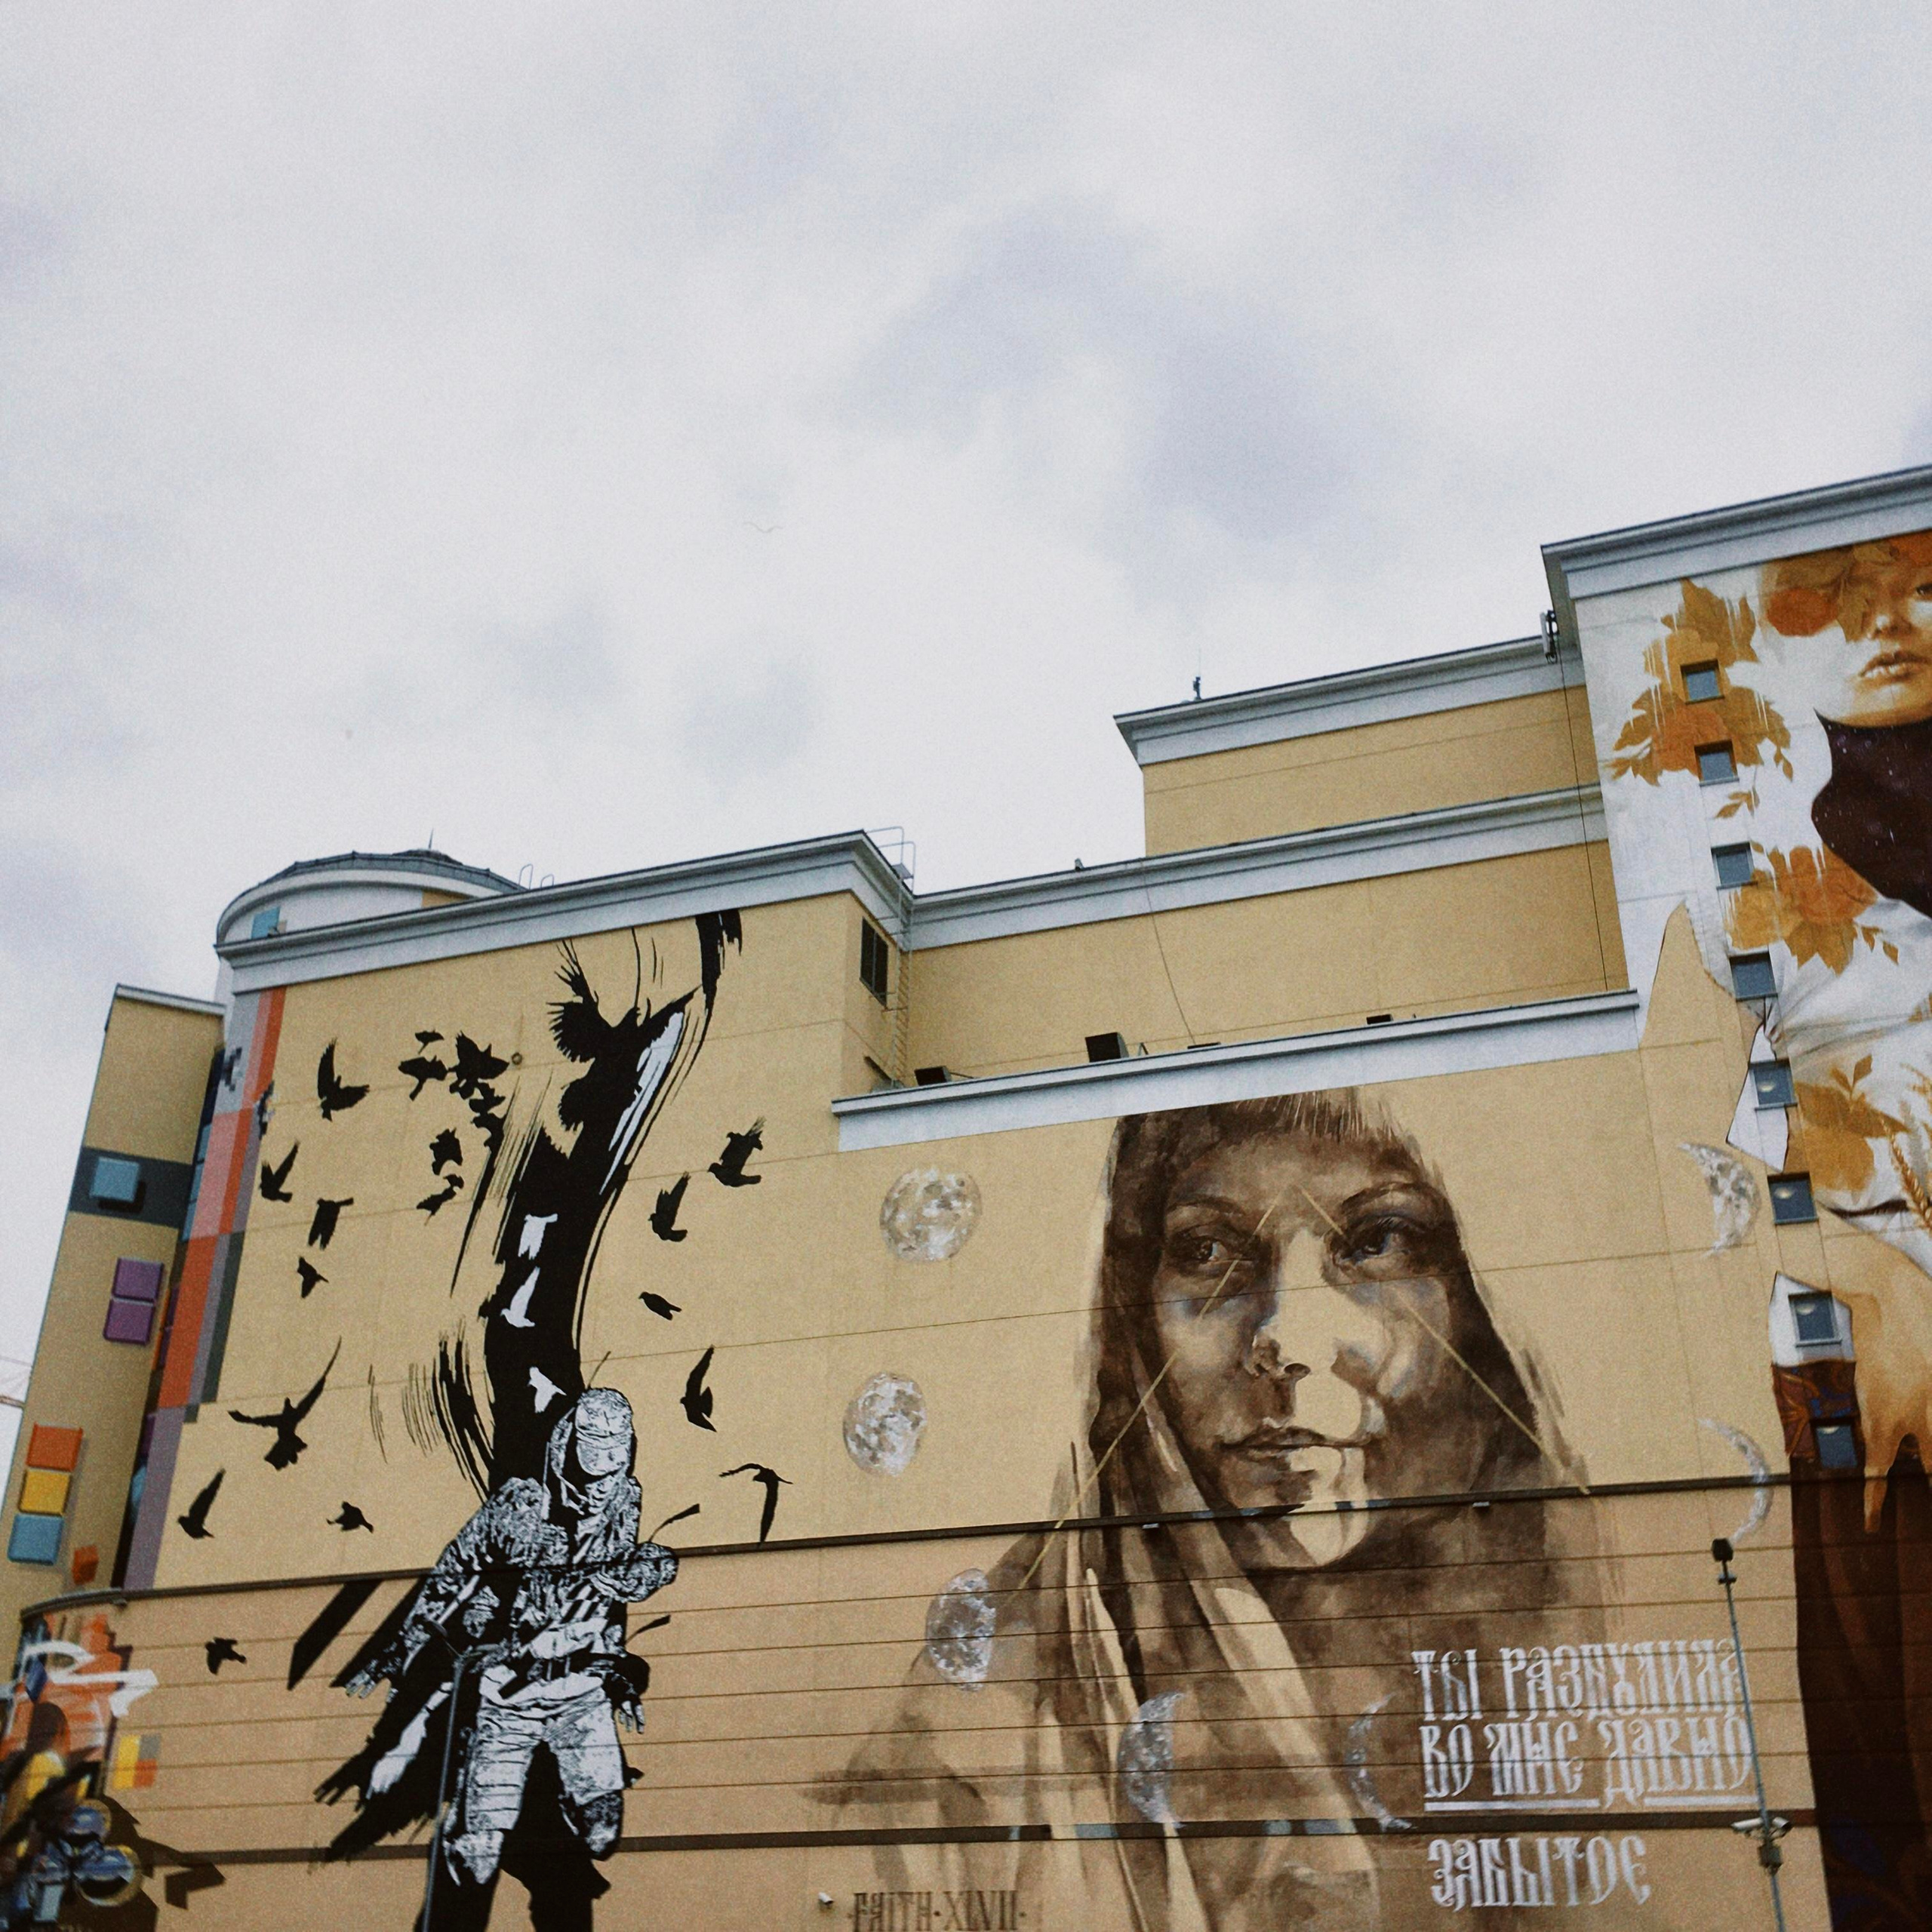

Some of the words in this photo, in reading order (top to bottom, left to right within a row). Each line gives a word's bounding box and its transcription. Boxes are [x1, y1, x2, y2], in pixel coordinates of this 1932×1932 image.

[1411, 1648, 1483, 1721] ТЫ
[1419, 1724, 1474, 1798] ВО
[1484, 1720, 1584, 1796] МНЕ
[1596, 1715, 1755, 1808] ДАВНО
[1428, 1835, 1651, 1912] ЗАБЫТОЕ
